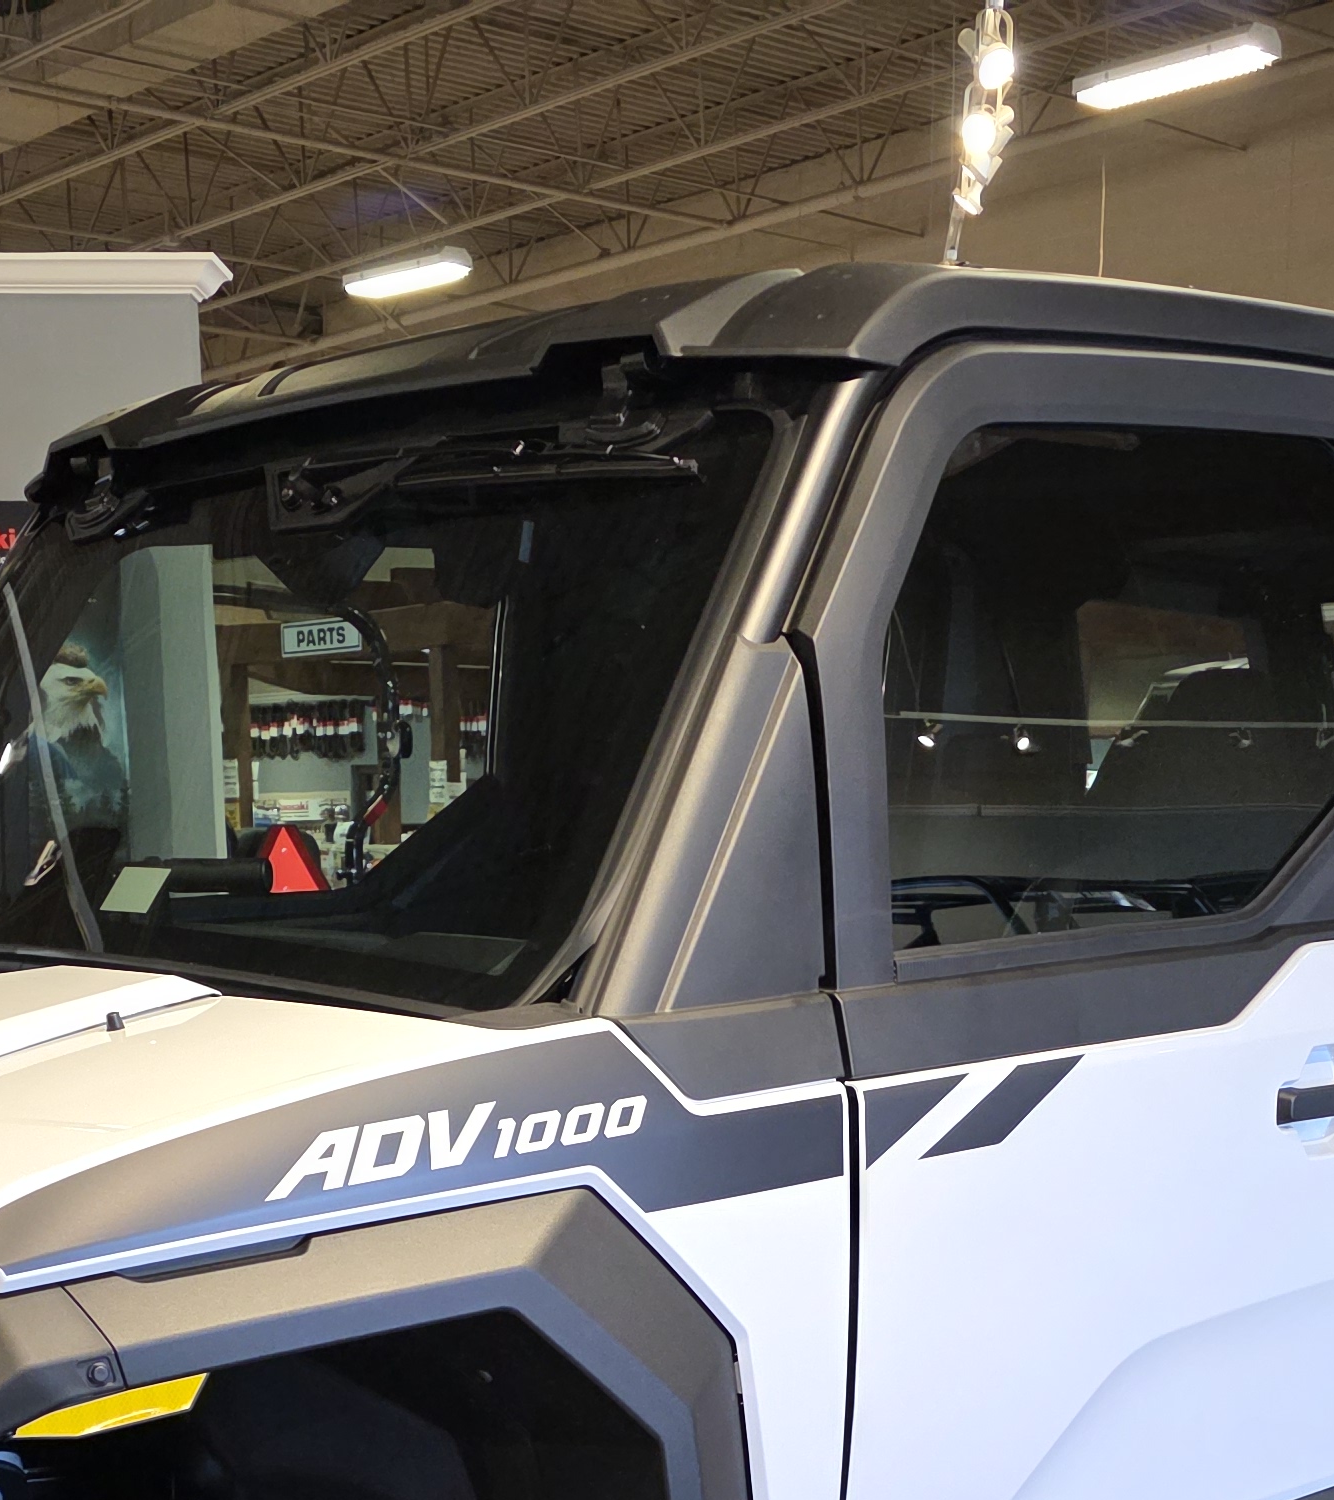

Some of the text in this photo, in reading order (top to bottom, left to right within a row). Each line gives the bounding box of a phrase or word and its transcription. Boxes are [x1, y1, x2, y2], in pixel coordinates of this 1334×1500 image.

[296, 625, 346, 648] PARTS
[264, 1094, 648, 1202] ADV 1000
